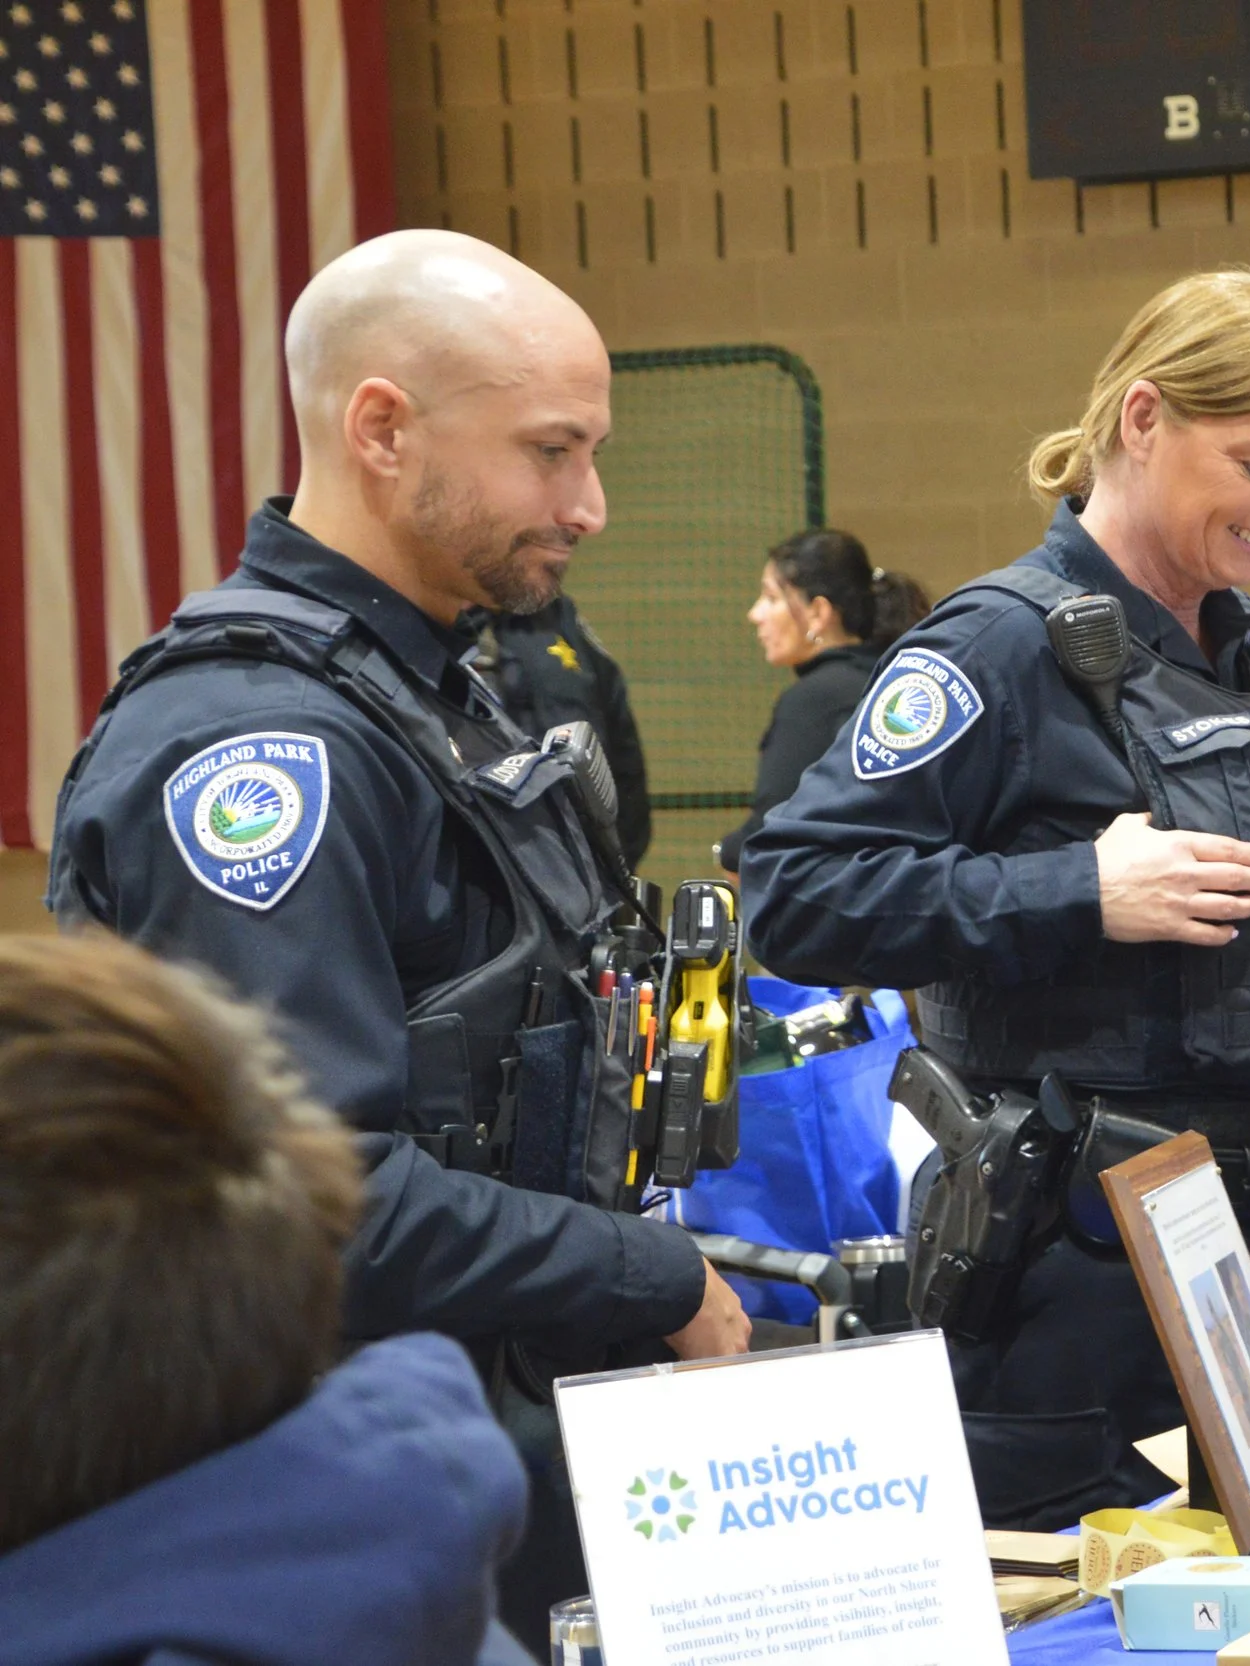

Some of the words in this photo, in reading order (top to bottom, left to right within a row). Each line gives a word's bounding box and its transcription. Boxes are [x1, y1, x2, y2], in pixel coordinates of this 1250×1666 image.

[1163, 94, 1200, 140] B
[896, 655, 950, 683] HIGHLAND
[946, 679, 974, 717] PARK
[858, 735, 900, 767] POLICE
[1171, 715, 1250, 741] STOKES
[172, 744, 257, 800] HIGHLAND
[263, 743, 314, 763] PARK
[220, 851, 294, 884] POLICE
[254, 881, 270, 895] IL
[707, 1436, 857, 1492] Insight
[718, 1474, 930, 1535] Advocacy
[649, 1597, 697, 1616] Insight
[702, 1584, 777, 1608] Advocacy's
[781, 1576, 830, 1594] mission
[832, 1571, 844, 1585] is
[846, 1570, 860, 1583] to
[864, 1561, 920, 1581] advocate
[922, 1556, 942, 1570] for
[660, 1614, 723, 1634] inclusion
[727, 1607, 751, 1623] and
[755, 1598, 811, 1619] diversity
[815, 1594, 829, 1608] in
[832, 1591, 855, 1604] our
[858, 1582, 897, 1599] North
[899, 1577, 937, 1594] Shore
[665, 1629, 741, 1654] community
[744, 1626, 761, 1642] by
[765, 1614, 830, 1639] providing
[832, 1604, 893, 1624] visibility,
[894, 1595, 943, 1613] insight,
[700, 1646, 764, 1666] resources
[766, 1643, 780, 1656] to
[783, 1632, 835, 1653] support
[837, 1622, 888, 1642] families
[891, 1618, 905, 1633] of
[907, 1614, 945, 1630] color.
